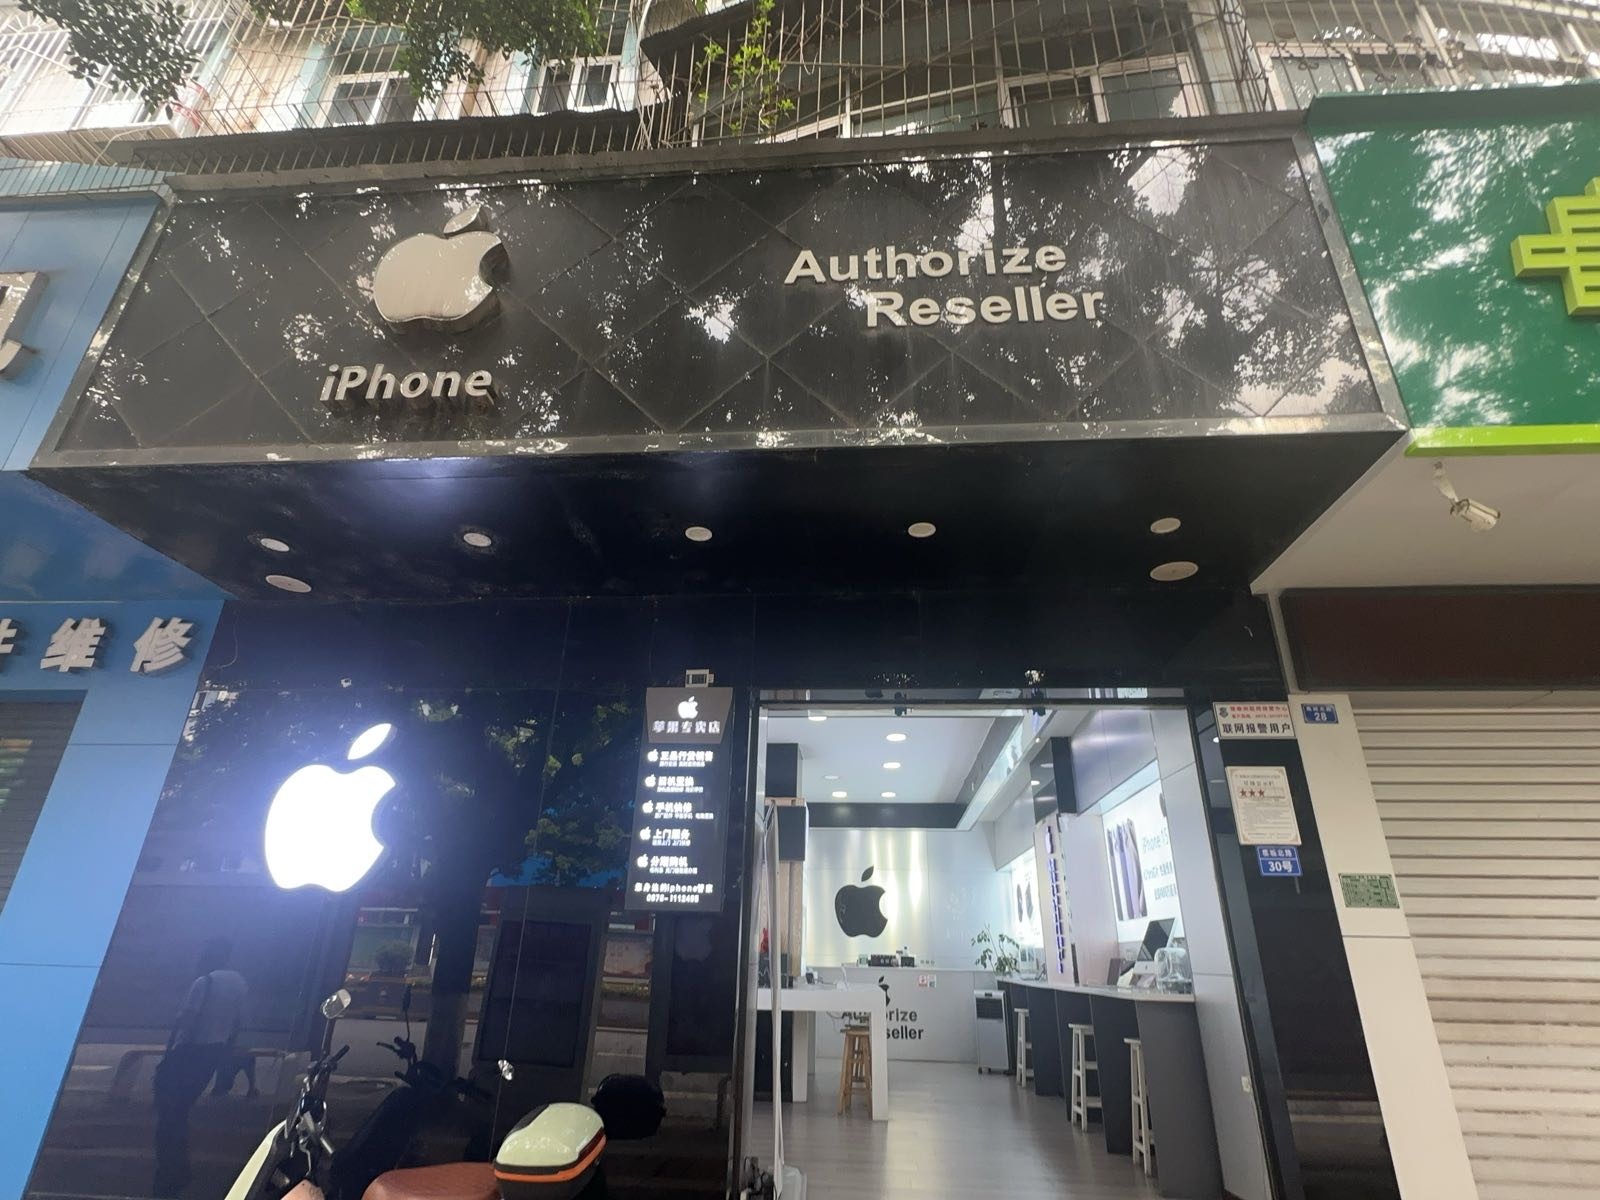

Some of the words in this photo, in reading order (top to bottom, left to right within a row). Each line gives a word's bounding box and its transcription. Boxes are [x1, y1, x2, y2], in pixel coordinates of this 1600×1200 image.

[784, 243, 1067, 284] Authorize
[866, 285, 1105, 328] Reseller
[319, 363, 493, 402] iPhone
[653, 720, 721, 734] 苹果专卖店
[1222, 723, 1291, 734] 联网报警用户
[652, 829, 691, 840] 上门服务
[1268, 860, 1293, 873] 30号
